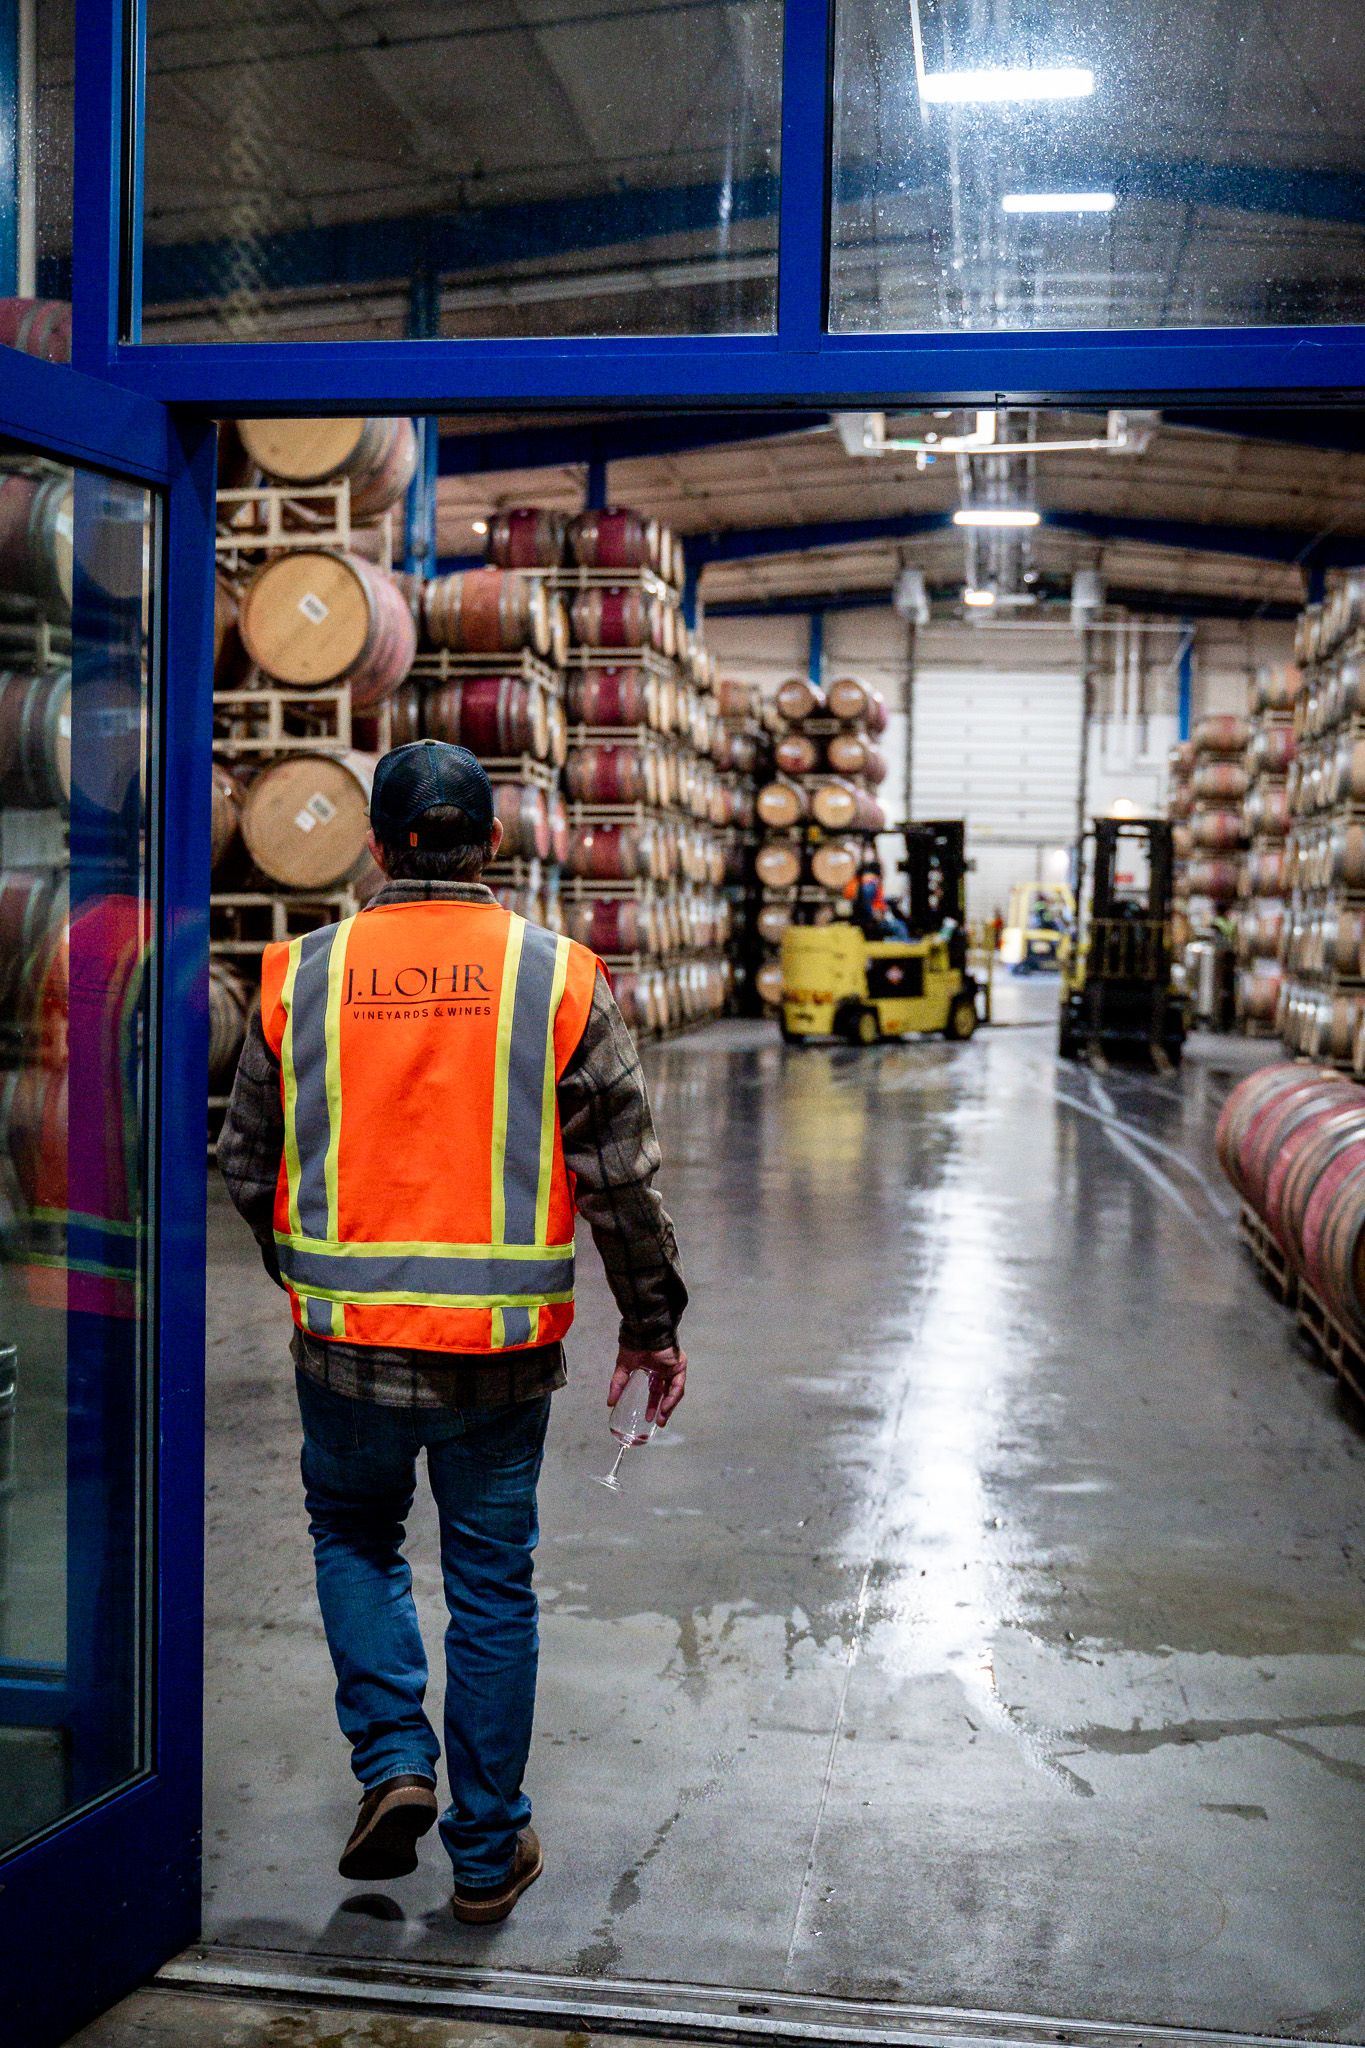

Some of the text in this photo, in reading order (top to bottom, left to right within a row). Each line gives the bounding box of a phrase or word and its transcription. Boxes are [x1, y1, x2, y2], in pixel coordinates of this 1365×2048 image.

[353, 1006, 491, 1020] VINEYARDS & WINES
